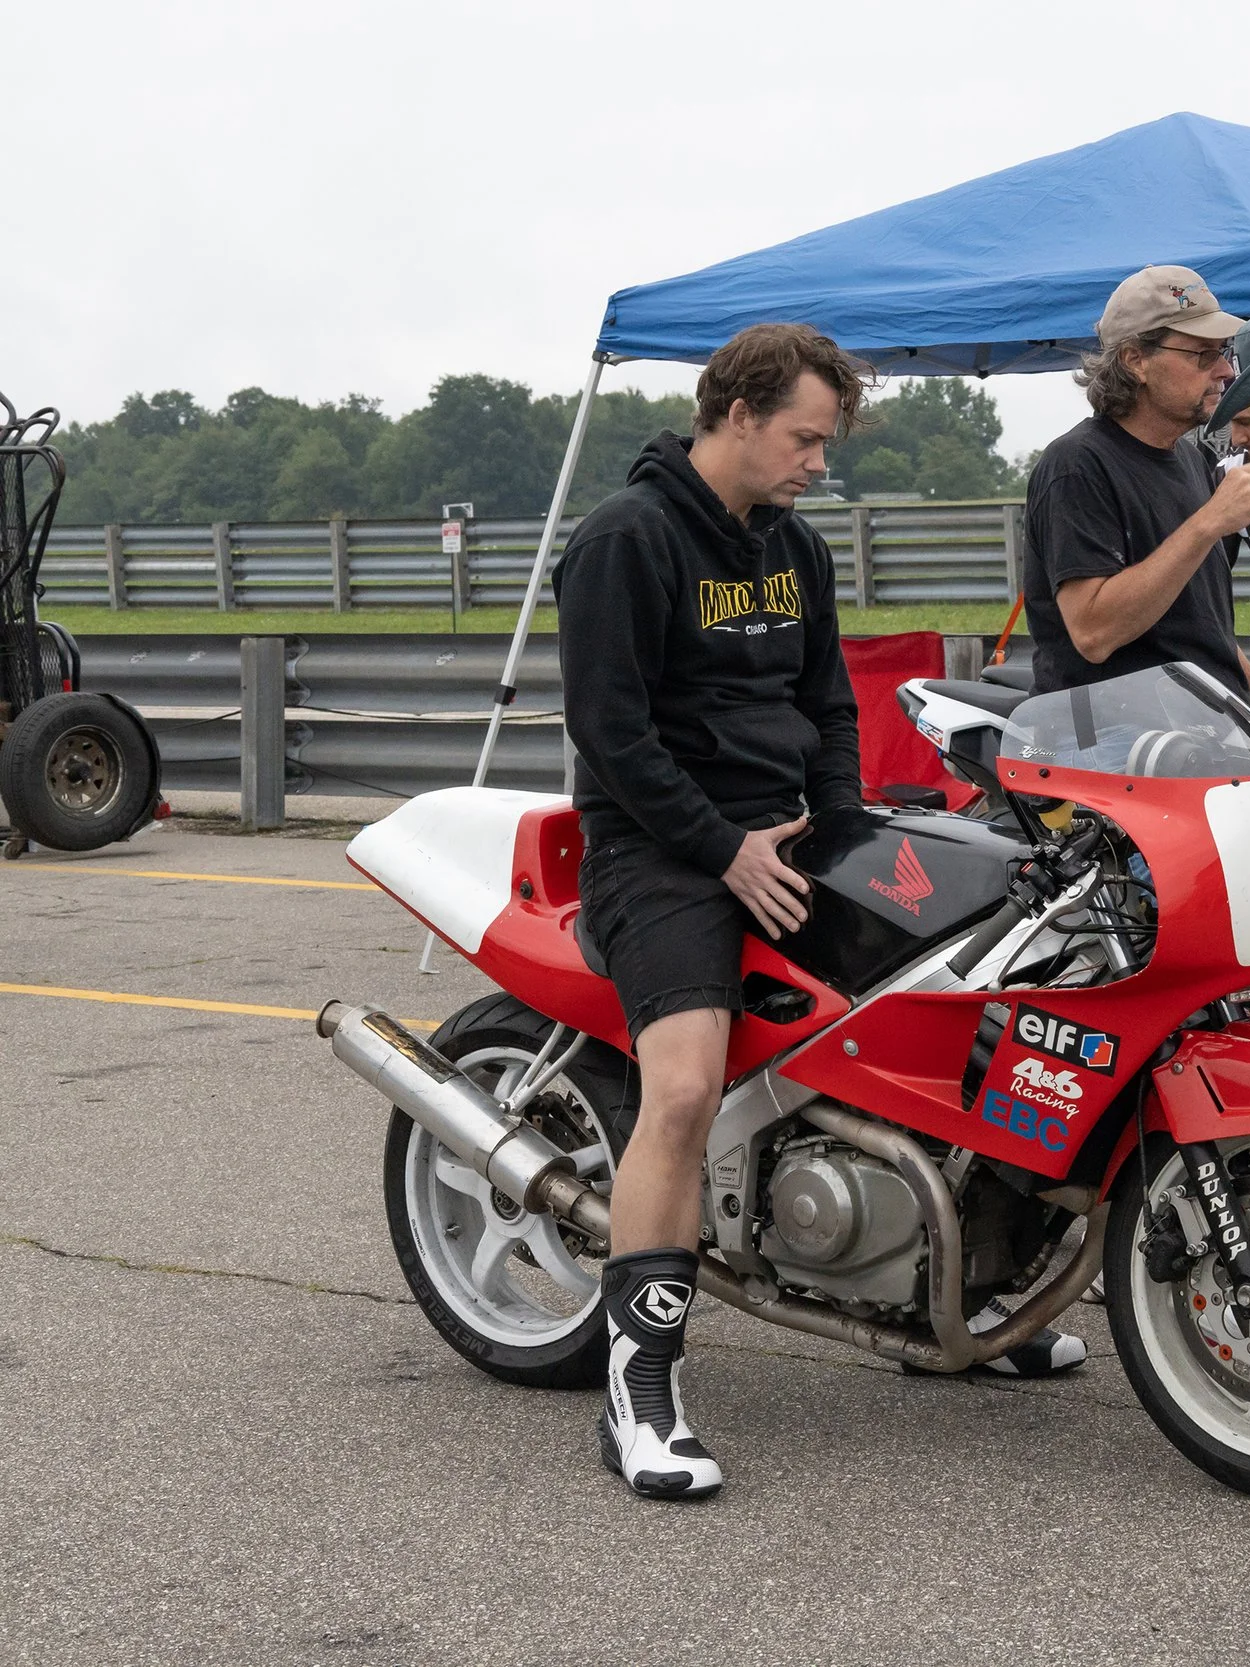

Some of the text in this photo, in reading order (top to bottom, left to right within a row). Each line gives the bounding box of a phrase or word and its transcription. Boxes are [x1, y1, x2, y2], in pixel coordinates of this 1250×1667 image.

[867, 877, 920, 917] HONDA
[1018, 1014, 1078, 1055] elf
[1010, 1077, 1080, 1120] Racing
[1012, 1057, 1084, 1100] 4&6
[981, 1088, 1069, 1153] EBC
[1198, 1161, 1248, 1262] DUNLOP
[411, 1269, 487, 1356] METZELER
